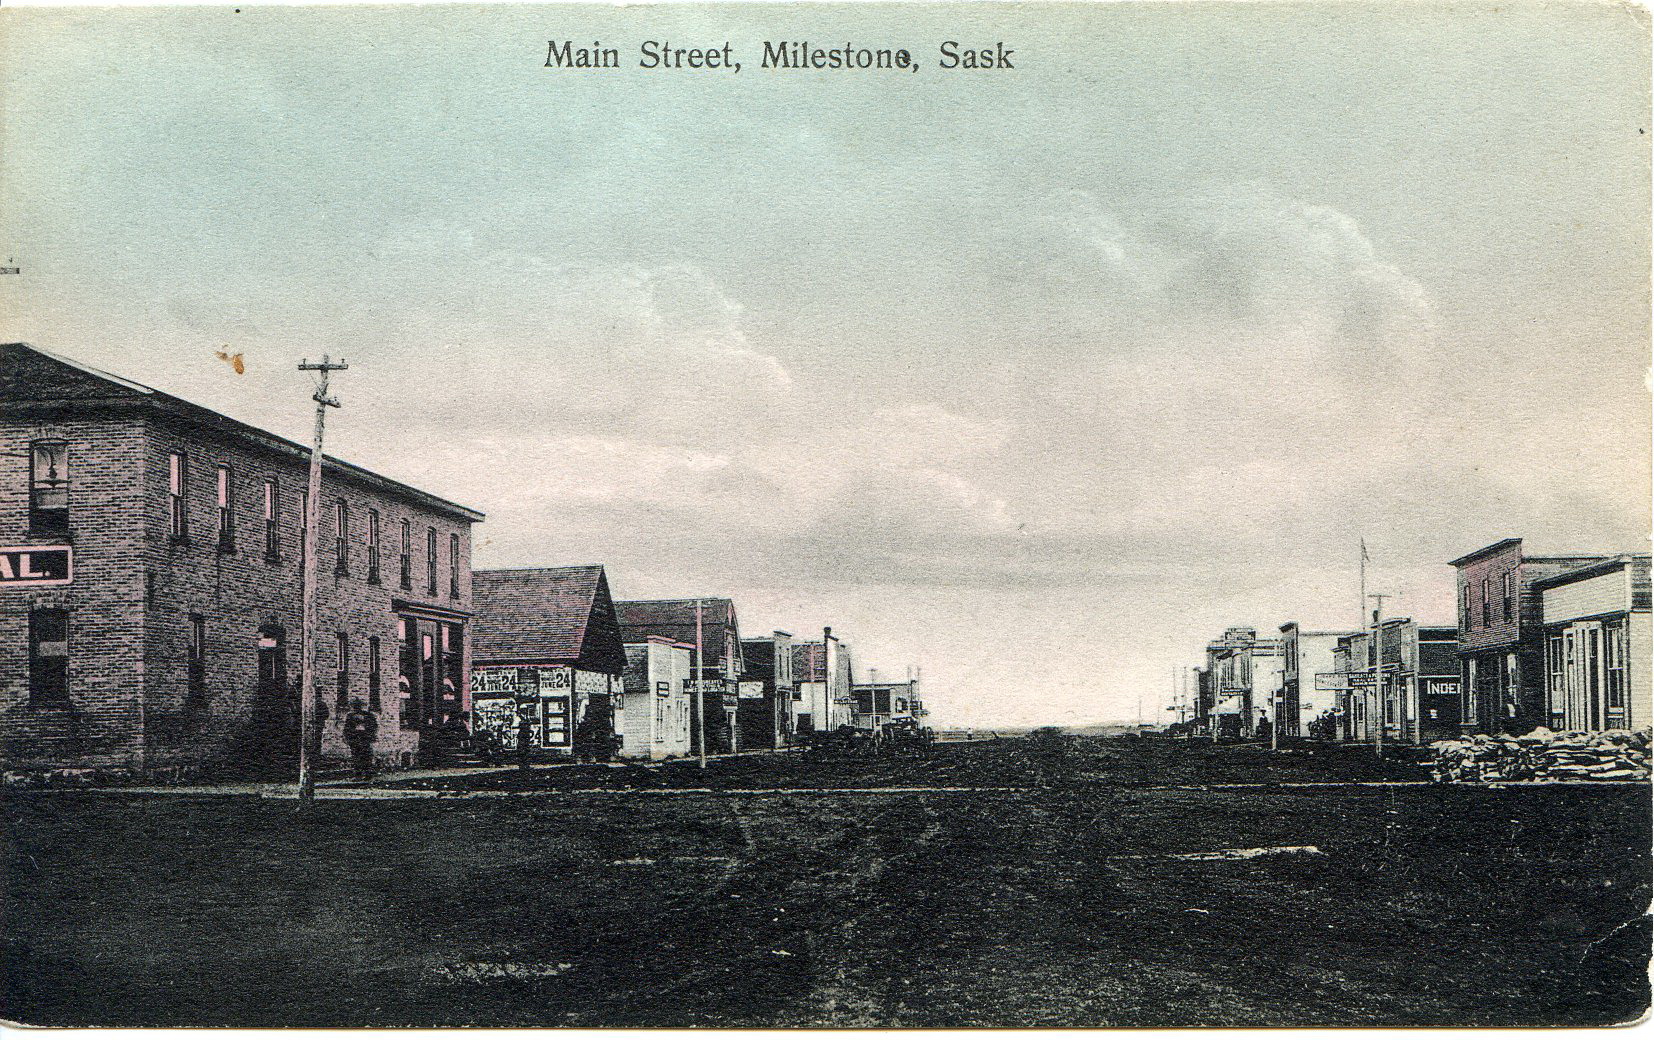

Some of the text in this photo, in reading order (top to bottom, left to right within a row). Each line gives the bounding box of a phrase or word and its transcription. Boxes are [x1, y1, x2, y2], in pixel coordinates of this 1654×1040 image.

[471, 675, 487, 692] 24
[501, 674, 517, 692] 24
[541, 681, 557, 689] JUNE
[556, 672, 571, 689] 24
